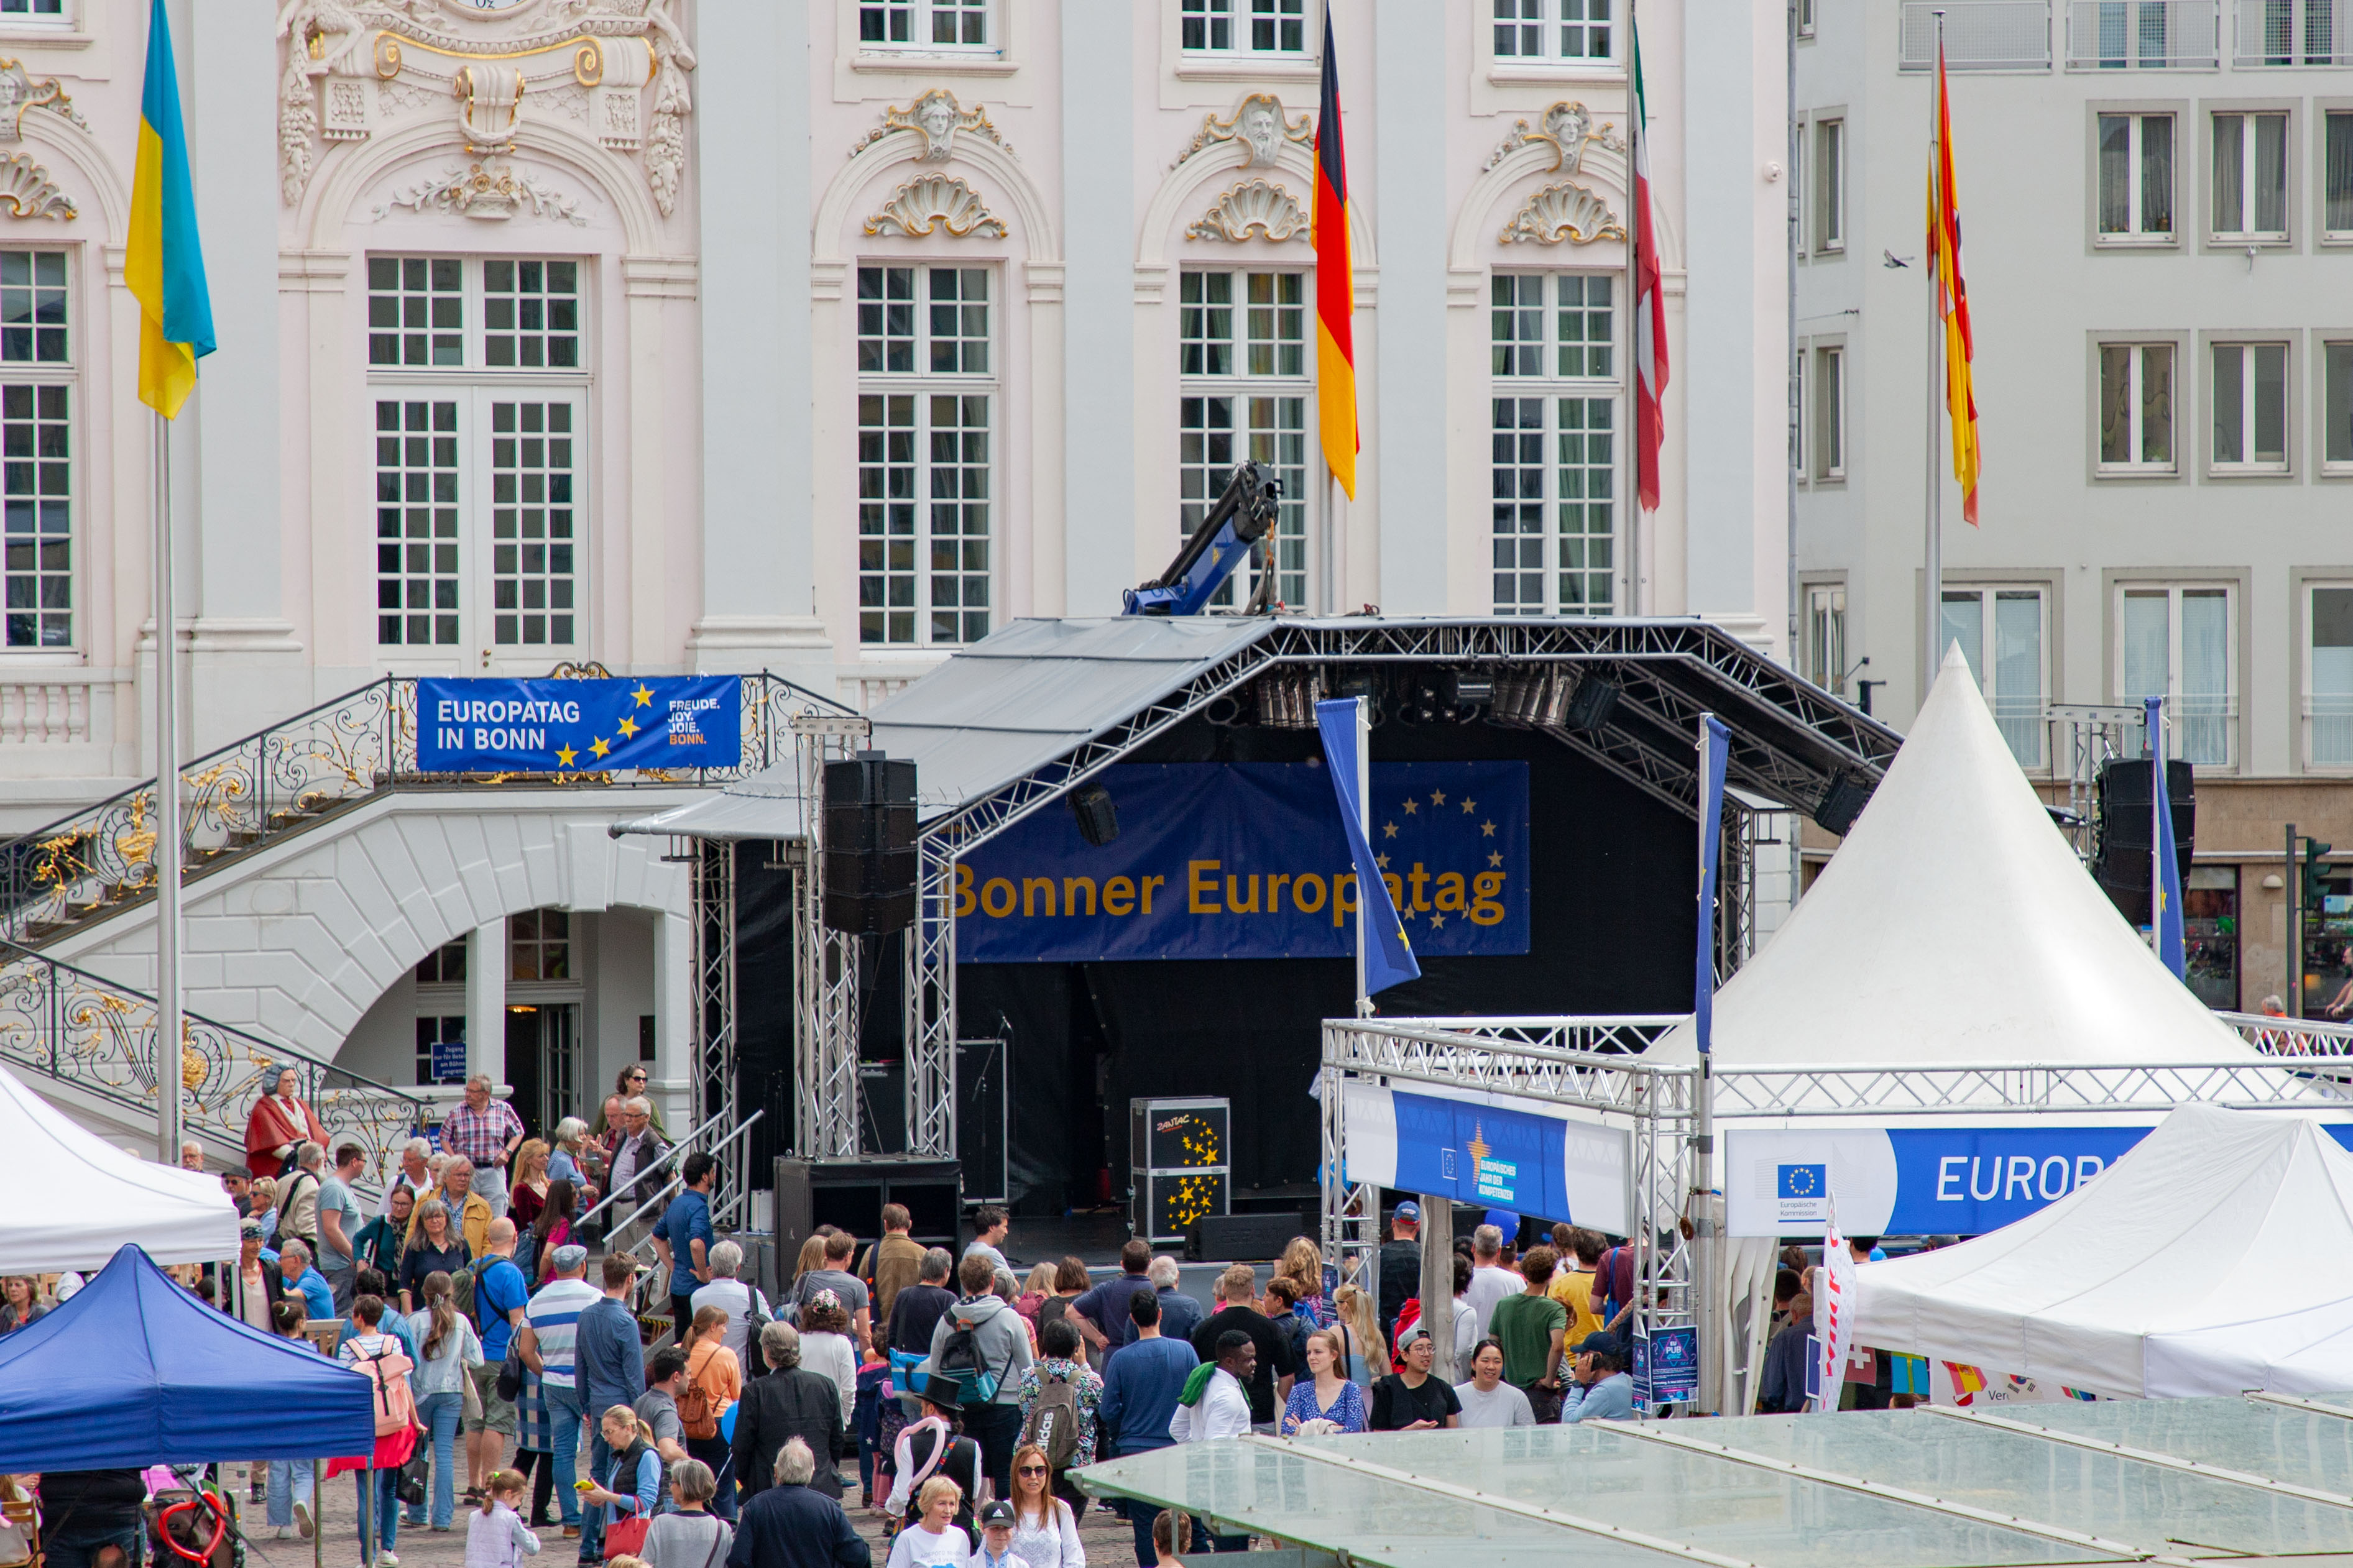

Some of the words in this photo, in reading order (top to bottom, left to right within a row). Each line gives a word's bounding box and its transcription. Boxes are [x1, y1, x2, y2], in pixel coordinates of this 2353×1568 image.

[438, 700, 580, 723] EUROPATAG
[669, 699, 721, 712] FREUDE.
[668, 711, 694, 723] JOY.
[668, 722, 700, 734] JOIE.
[438, 727, 464, 749] IN
[474, 728, 545, 751] BONN
[669, 733, 707, 746] BONN.
[944, 863, 1164, 918] Bonner
[1189, 860, 1506, 928] Europatag
[1480, 1172, 1493, 1184] JAHR
[1493, 1175, 1503, 1186] DER
[1936, 1155, 2123, 1201] EUROP
[1479, 1184, 1514, 1200] KOMPETENZEN
[1780, 1201, 1817, 1209] Europäische
[1666, 1346, 1682, 1354] PUB
[1036, 1412, 1054, 1459] didas
